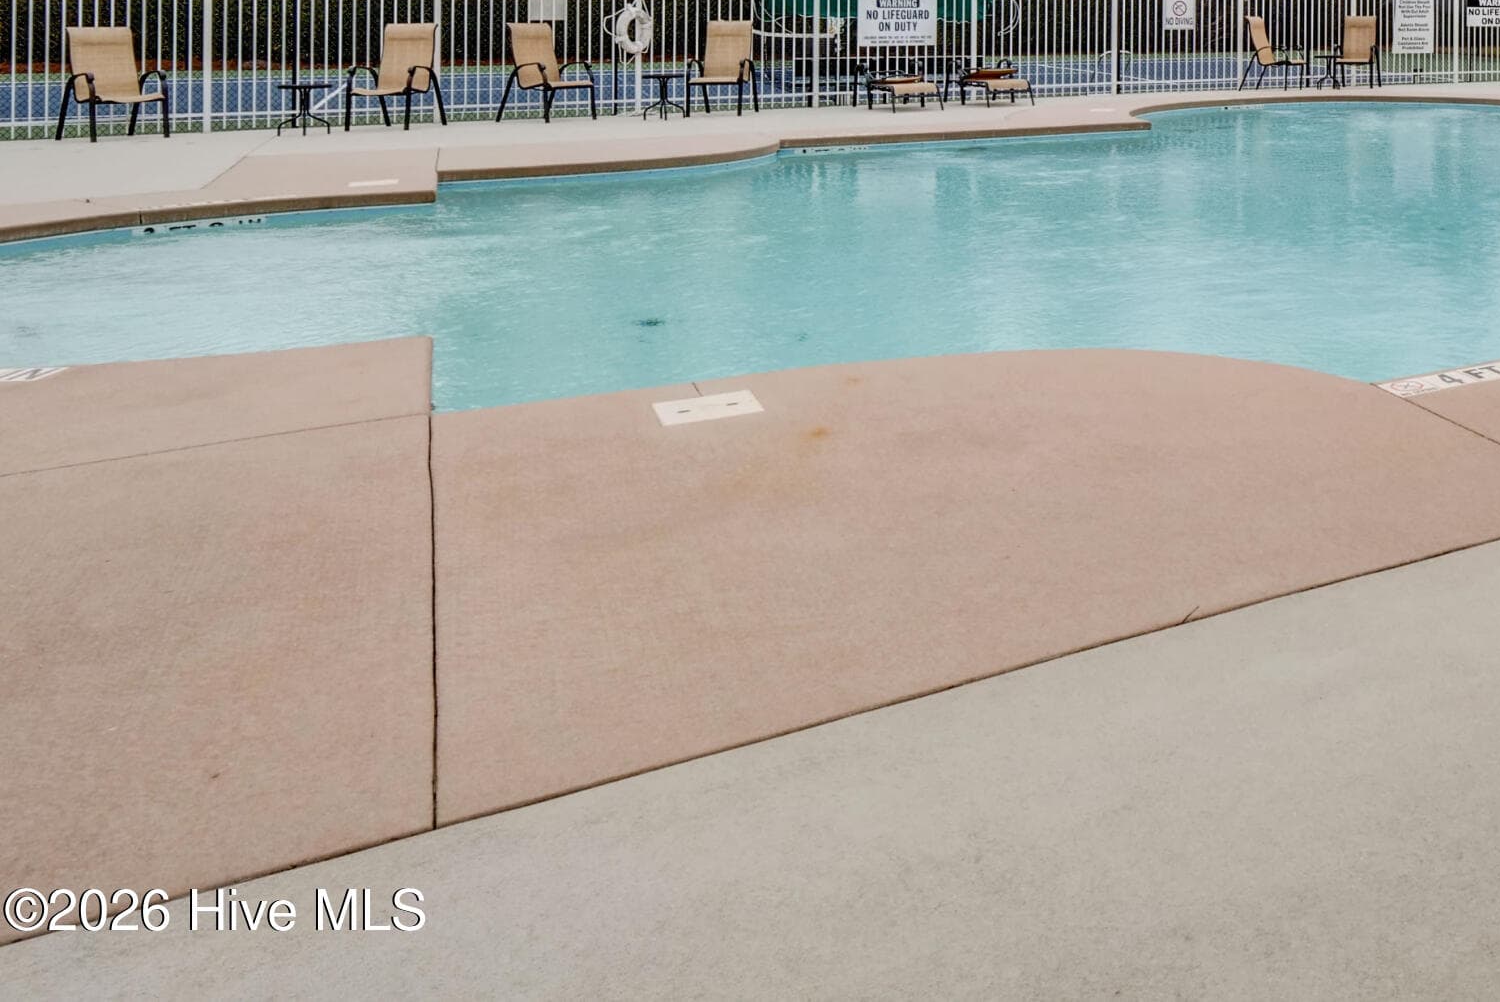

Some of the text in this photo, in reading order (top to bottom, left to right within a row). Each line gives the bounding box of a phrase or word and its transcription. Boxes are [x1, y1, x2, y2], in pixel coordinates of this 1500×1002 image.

[880, 0, 918, 7] WARNING
[866, 10, 930, 19] NO LIFEGUARD
[1166, 17, 1193, 25] NO DIVING
[878, 22, 918, 31] ON DUTY
[1438, 374, 1464, 385] 4
